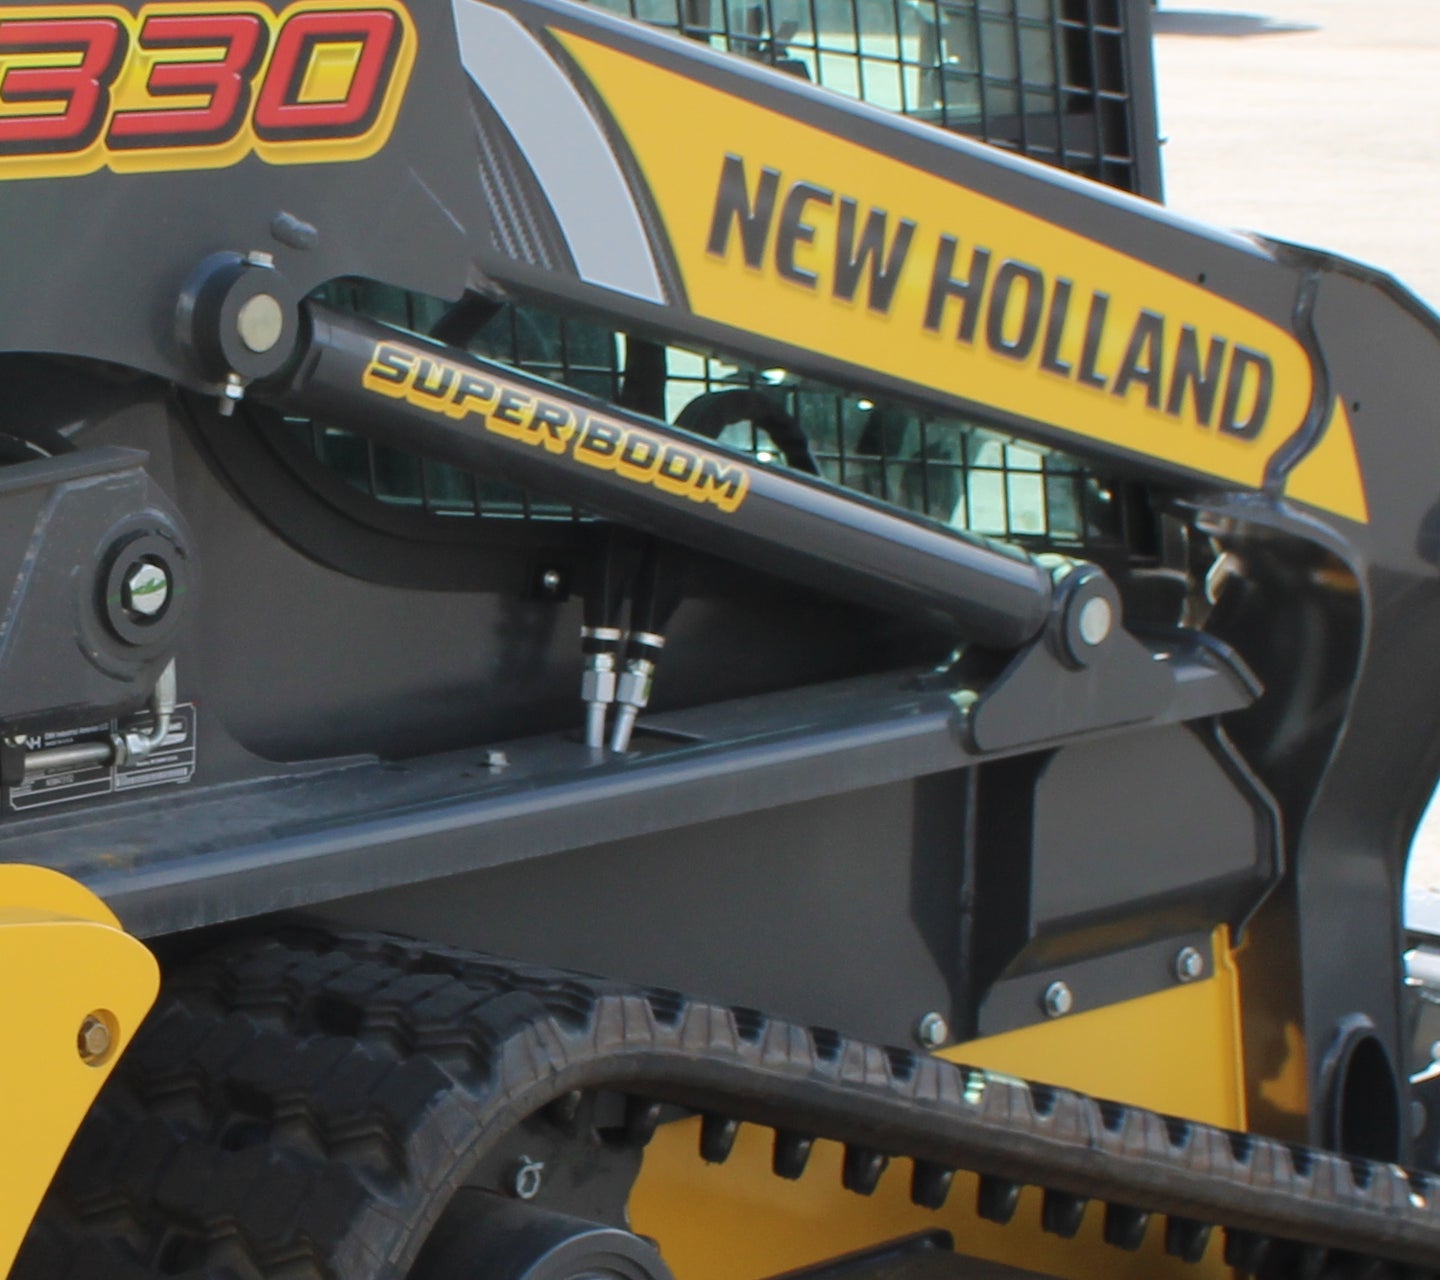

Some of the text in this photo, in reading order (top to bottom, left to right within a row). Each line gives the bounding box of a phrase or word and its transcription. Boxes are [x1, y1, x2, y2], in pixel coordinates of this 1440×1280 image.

[705, 153, 1274, 443] NEW HOLLAND
[366, 343, 747, 508] SUPER BOOM
